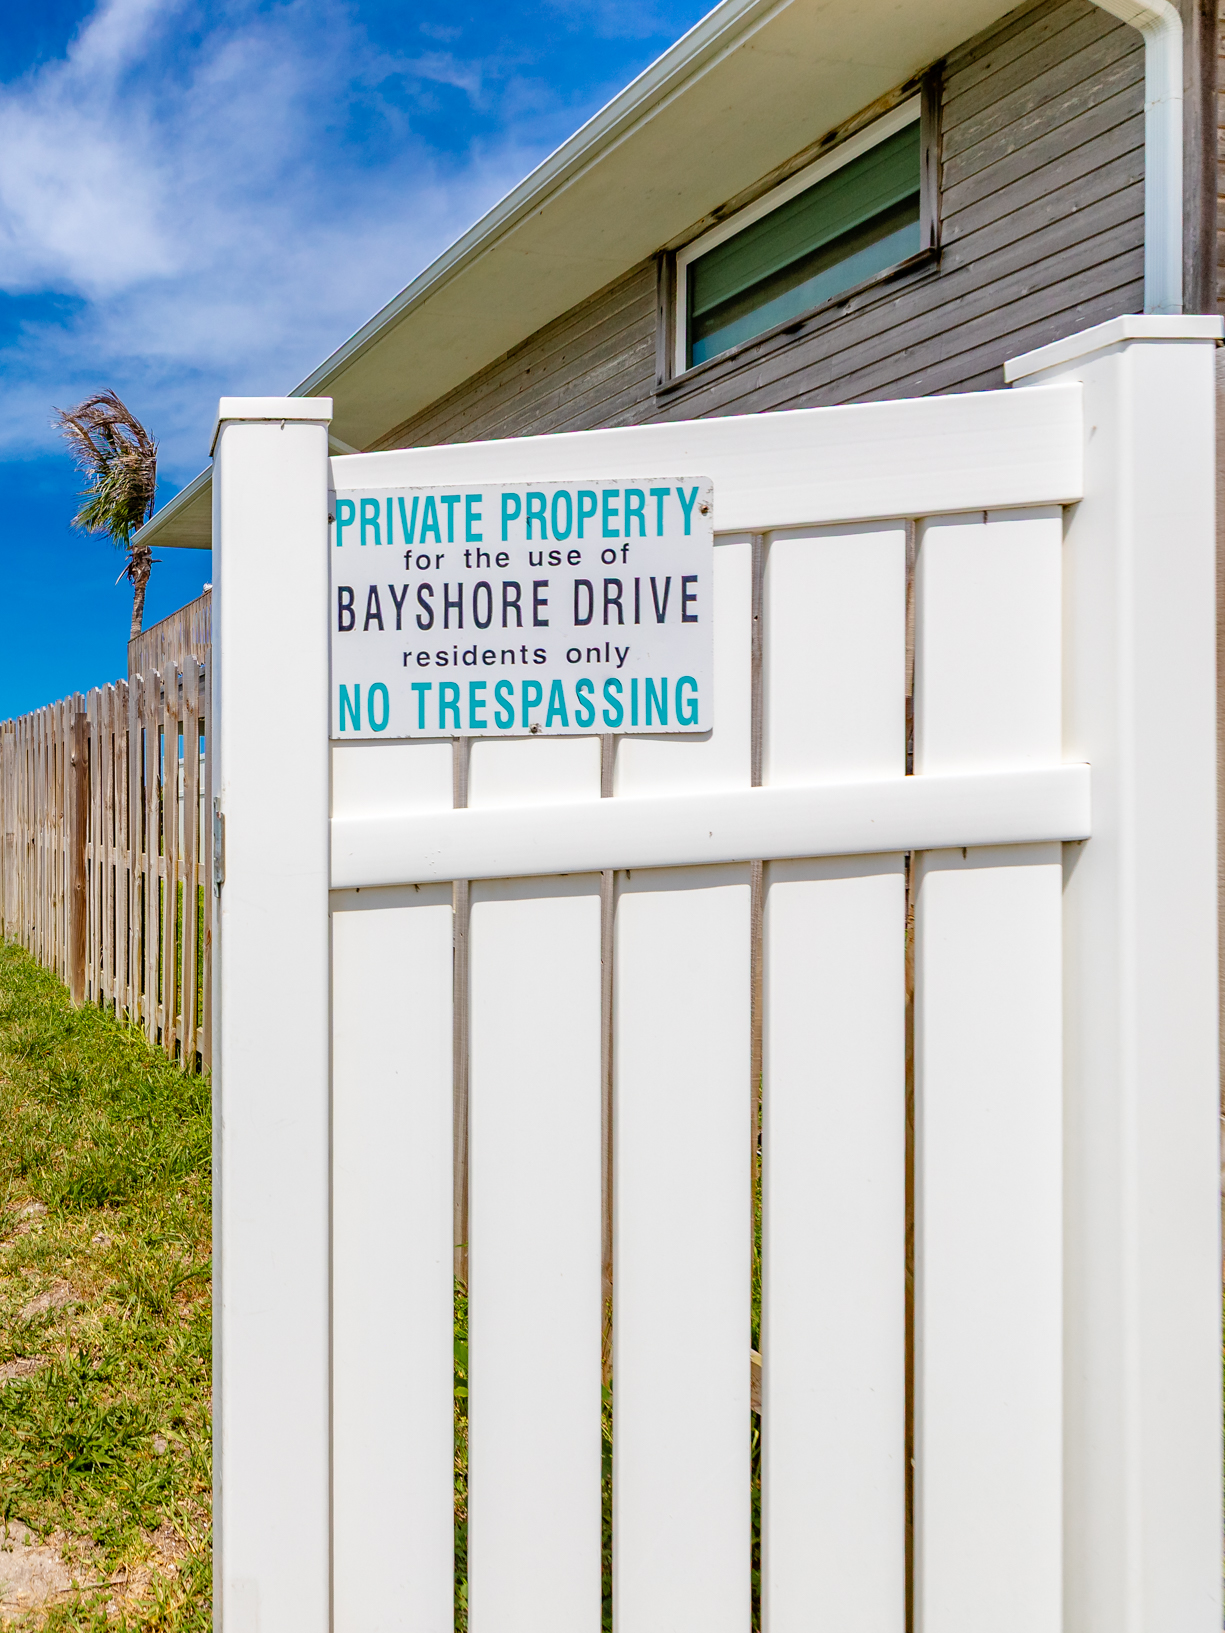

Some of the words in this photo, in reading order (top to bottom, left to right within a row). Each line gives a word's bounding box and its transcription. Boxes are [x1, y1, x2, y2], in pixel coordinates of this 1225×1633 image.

[336, 493, 483, 547] PRIVATE
[501, 486, 700, 542] PROPERTY
[404, 549, 445, 570] for
[463, 547, 510, 568] the
[528, 549, 582, 567] use
[600, 543, 631, 565] of
[337, 579, 550, 632] BAYSHORE
[573, 574, 699, 626] DRIVE
[402, 645, 547, 667] residents
[565, 641, 631, 668] only
[338, 682, 390, 732] NO
[411, 675, 700, 730] TRESPASSING
